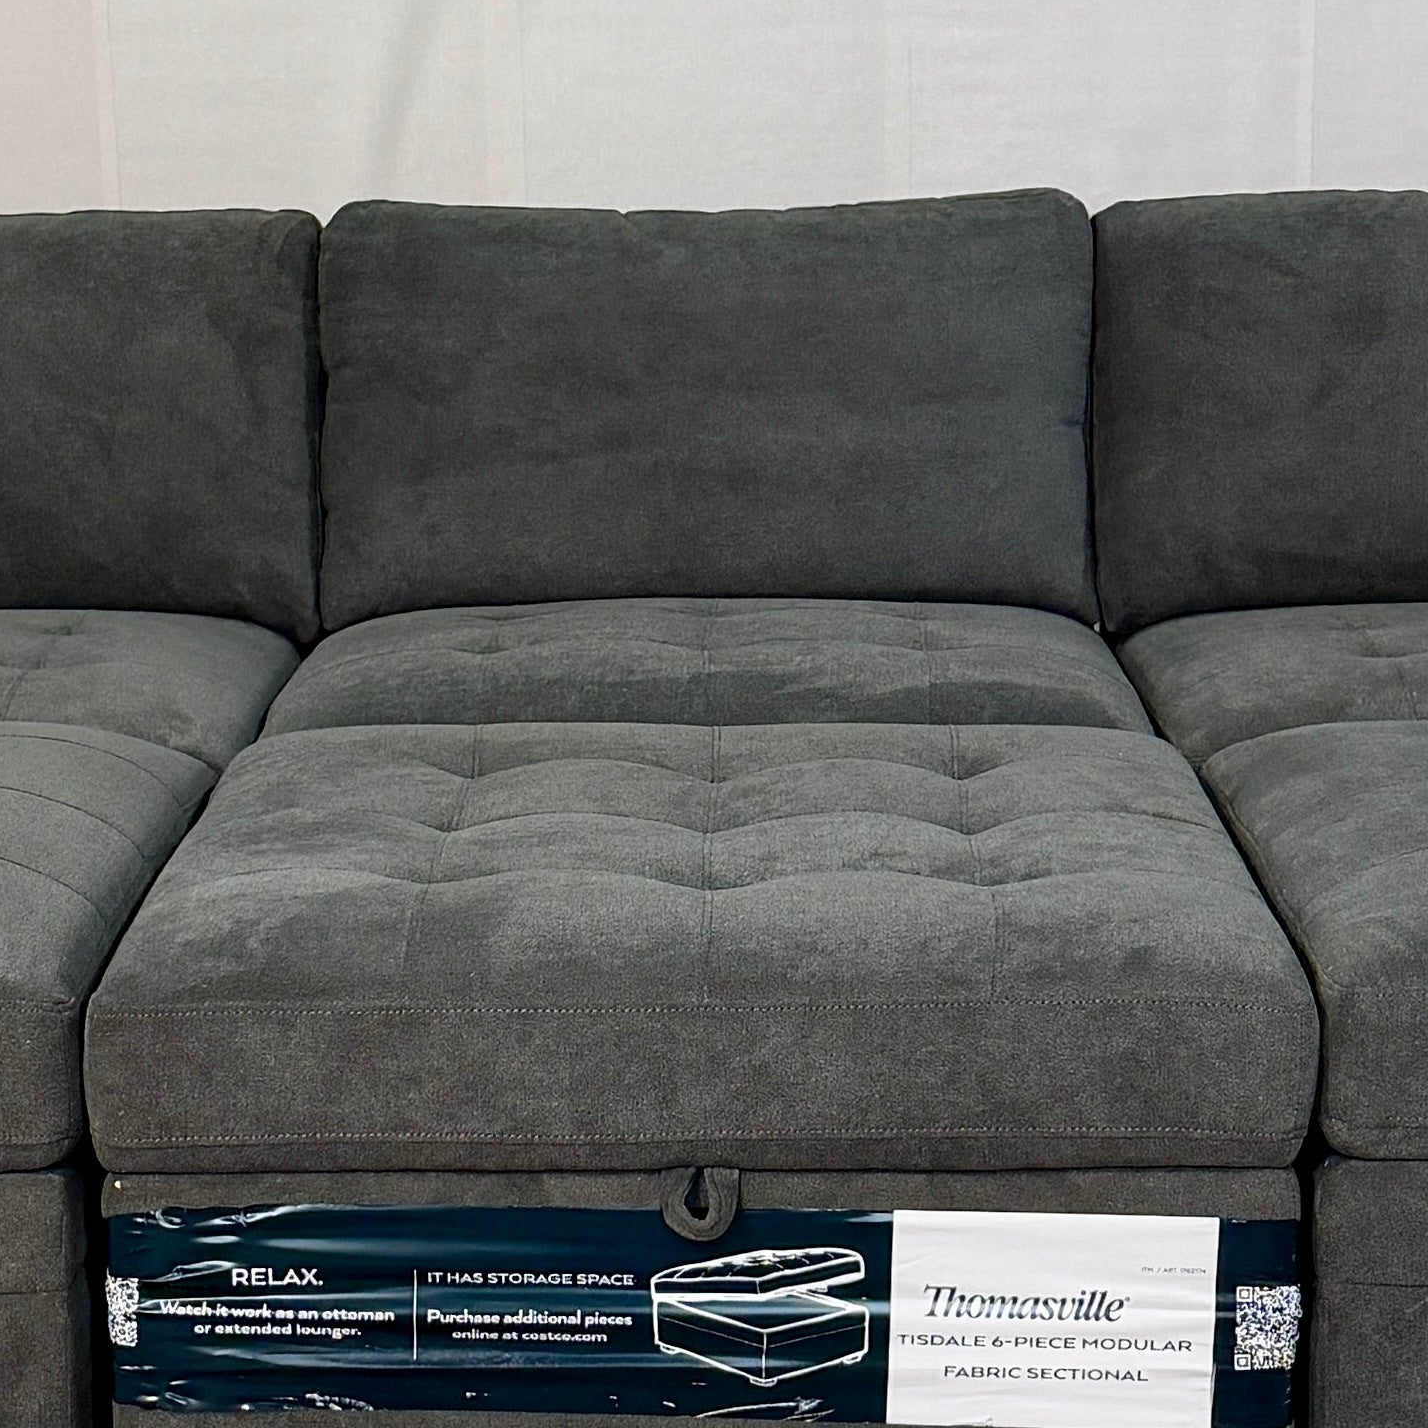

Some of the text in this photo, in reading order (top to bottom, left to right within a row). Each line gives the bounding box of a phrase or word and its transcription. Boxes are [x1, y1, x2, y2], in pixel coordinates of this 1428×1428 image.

[231, 1267, 324, 1287] RELAX.
[427, 1271, 443, 1284] IT
[447, 1272, 484, 1285] HAS
[487, 1272, 573, 1285] STORAGE
[159, 1299, 395, 1322] Watch it work as an ottoman
[427, 1308, 633, 1329] Purchase additional pieces
[194, 1322, 362, 1340] or extended lounger.
[452, 1329, 608, 1343] online at costco.com
[897, 1334, 1193, 1352] TISDALE 6-PIECE MODULAR
[944, 1365, 1149, 1382] FABRIC SECTIONAL
